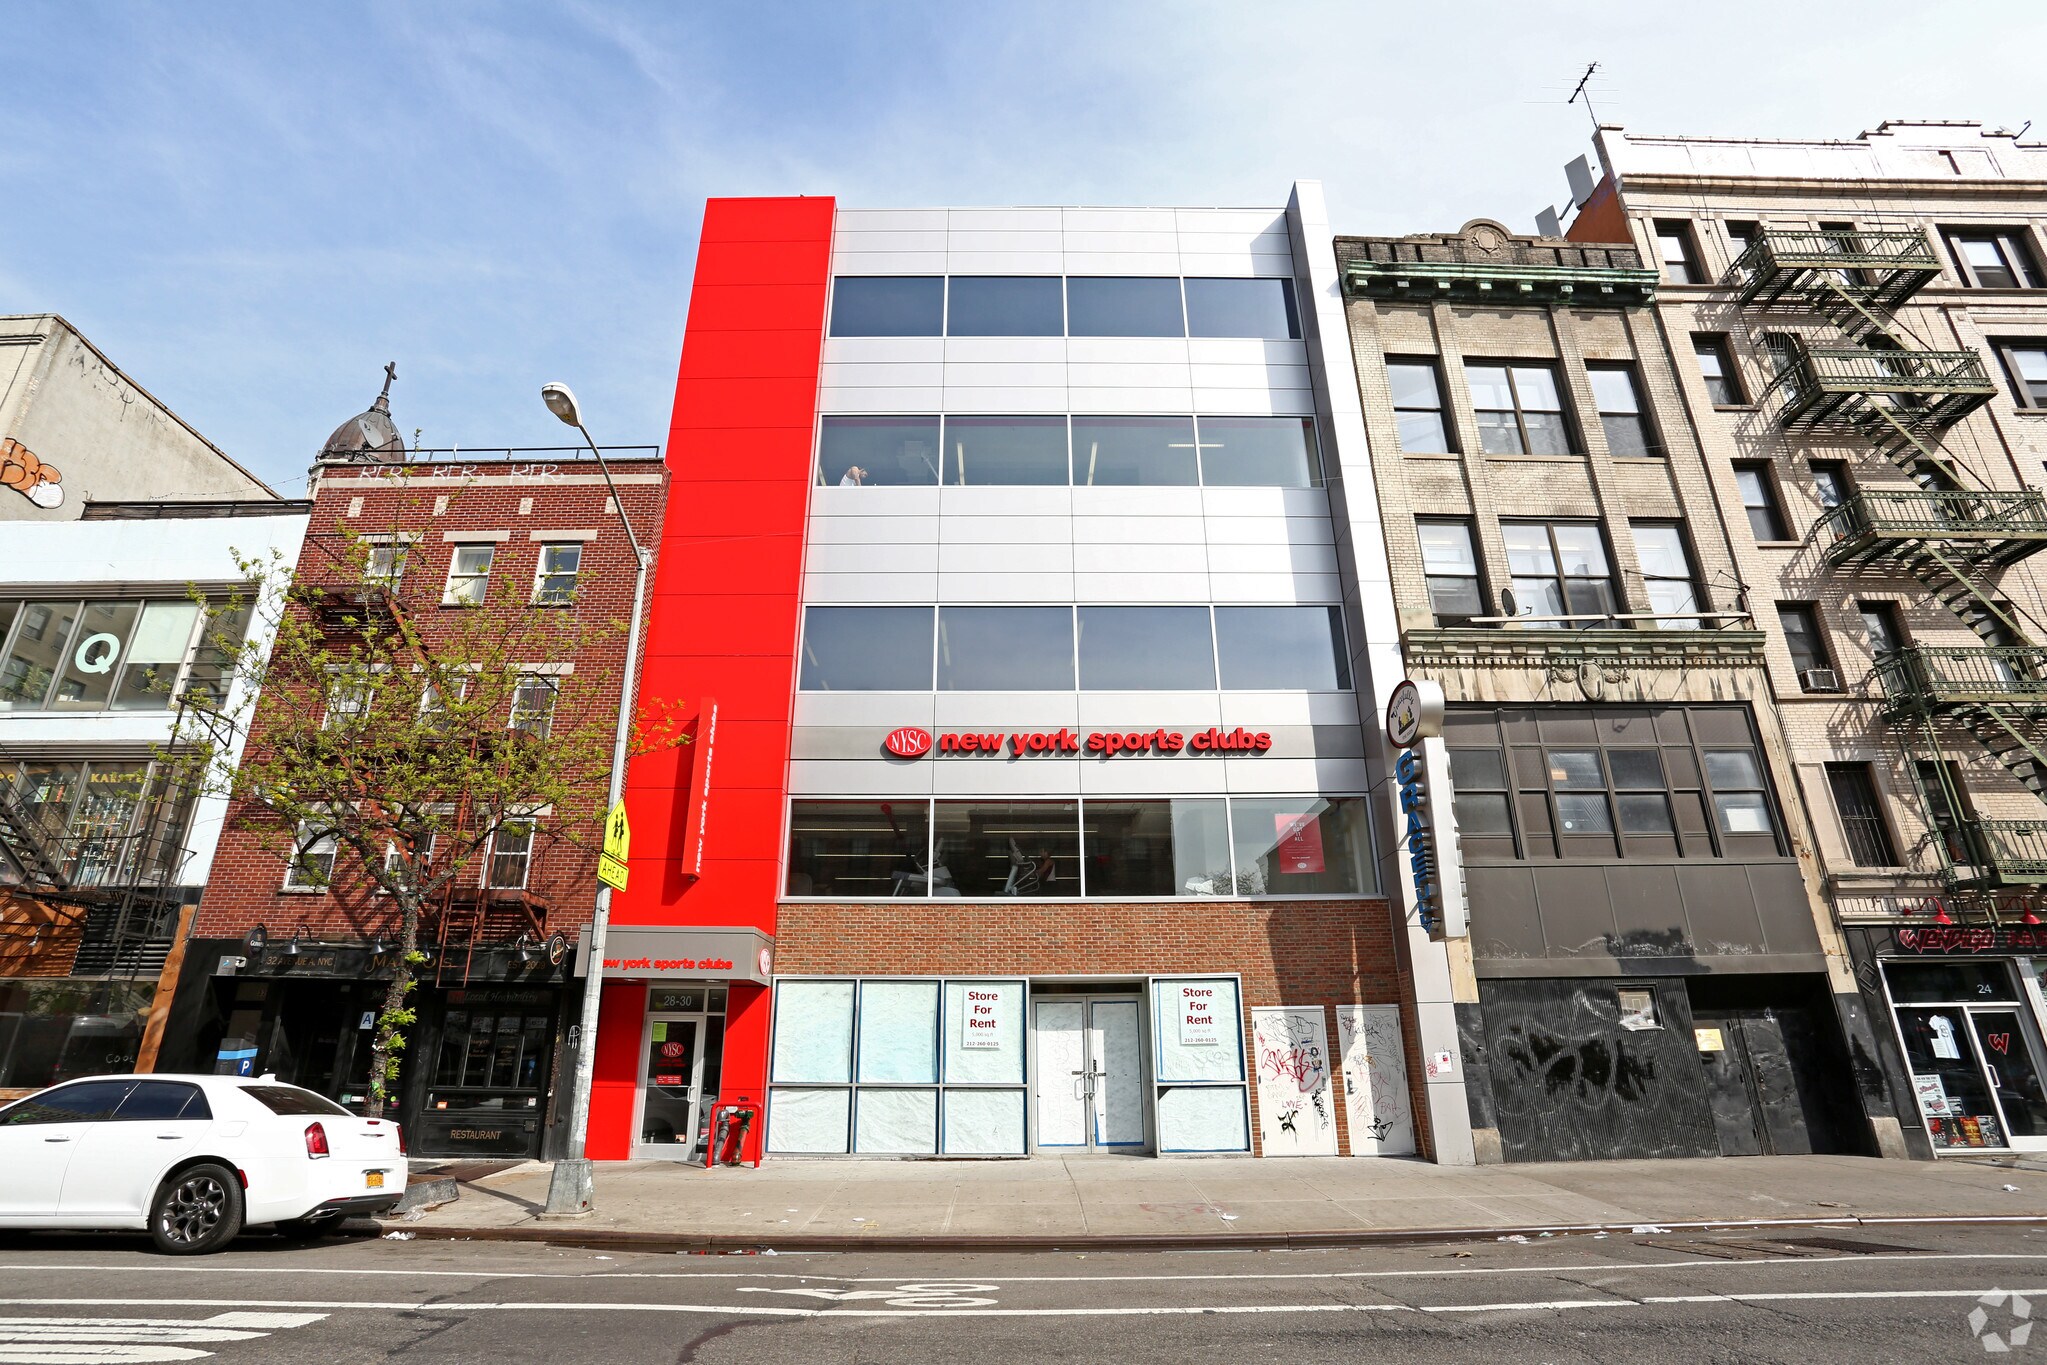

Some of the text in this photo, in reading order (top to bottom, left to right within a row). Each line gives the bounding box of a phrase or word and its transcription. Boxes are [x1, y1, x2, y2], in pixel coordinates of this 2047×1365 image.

[75, 633, 120, 675] Q
[890, 730, 928, 753] NYSC
[941, 727, 1273, 756] new york sports clubs
[601, 861, 625, 884] AHEAD
[266, 956, 278, 966] 32
[317, 956, 335, 966] NYC
[602, 956, 733, 971] ew york sports clubs
[1182, 988, 1213, 998] Store
[1977, 984, 1993, 994] 24
[664, 995, 692, 1007] 28-30
[968, 991, 998, 1001] Store
[974, 1005, 993, 1014] For
[1189, 1001, 1208, 1011] For
[362, 1014, 372, 1025] A
[970, 1018, 997, 1028] Rent
[1186, 1015, 1213, 1025] Rent
[663, 1042, 681, 1056] NYSC
[1988, 1033, 2009, 1056] W
[241, 1060, 250, 1075] P
[450, 1129, 502, 1140] RESTAURANT
